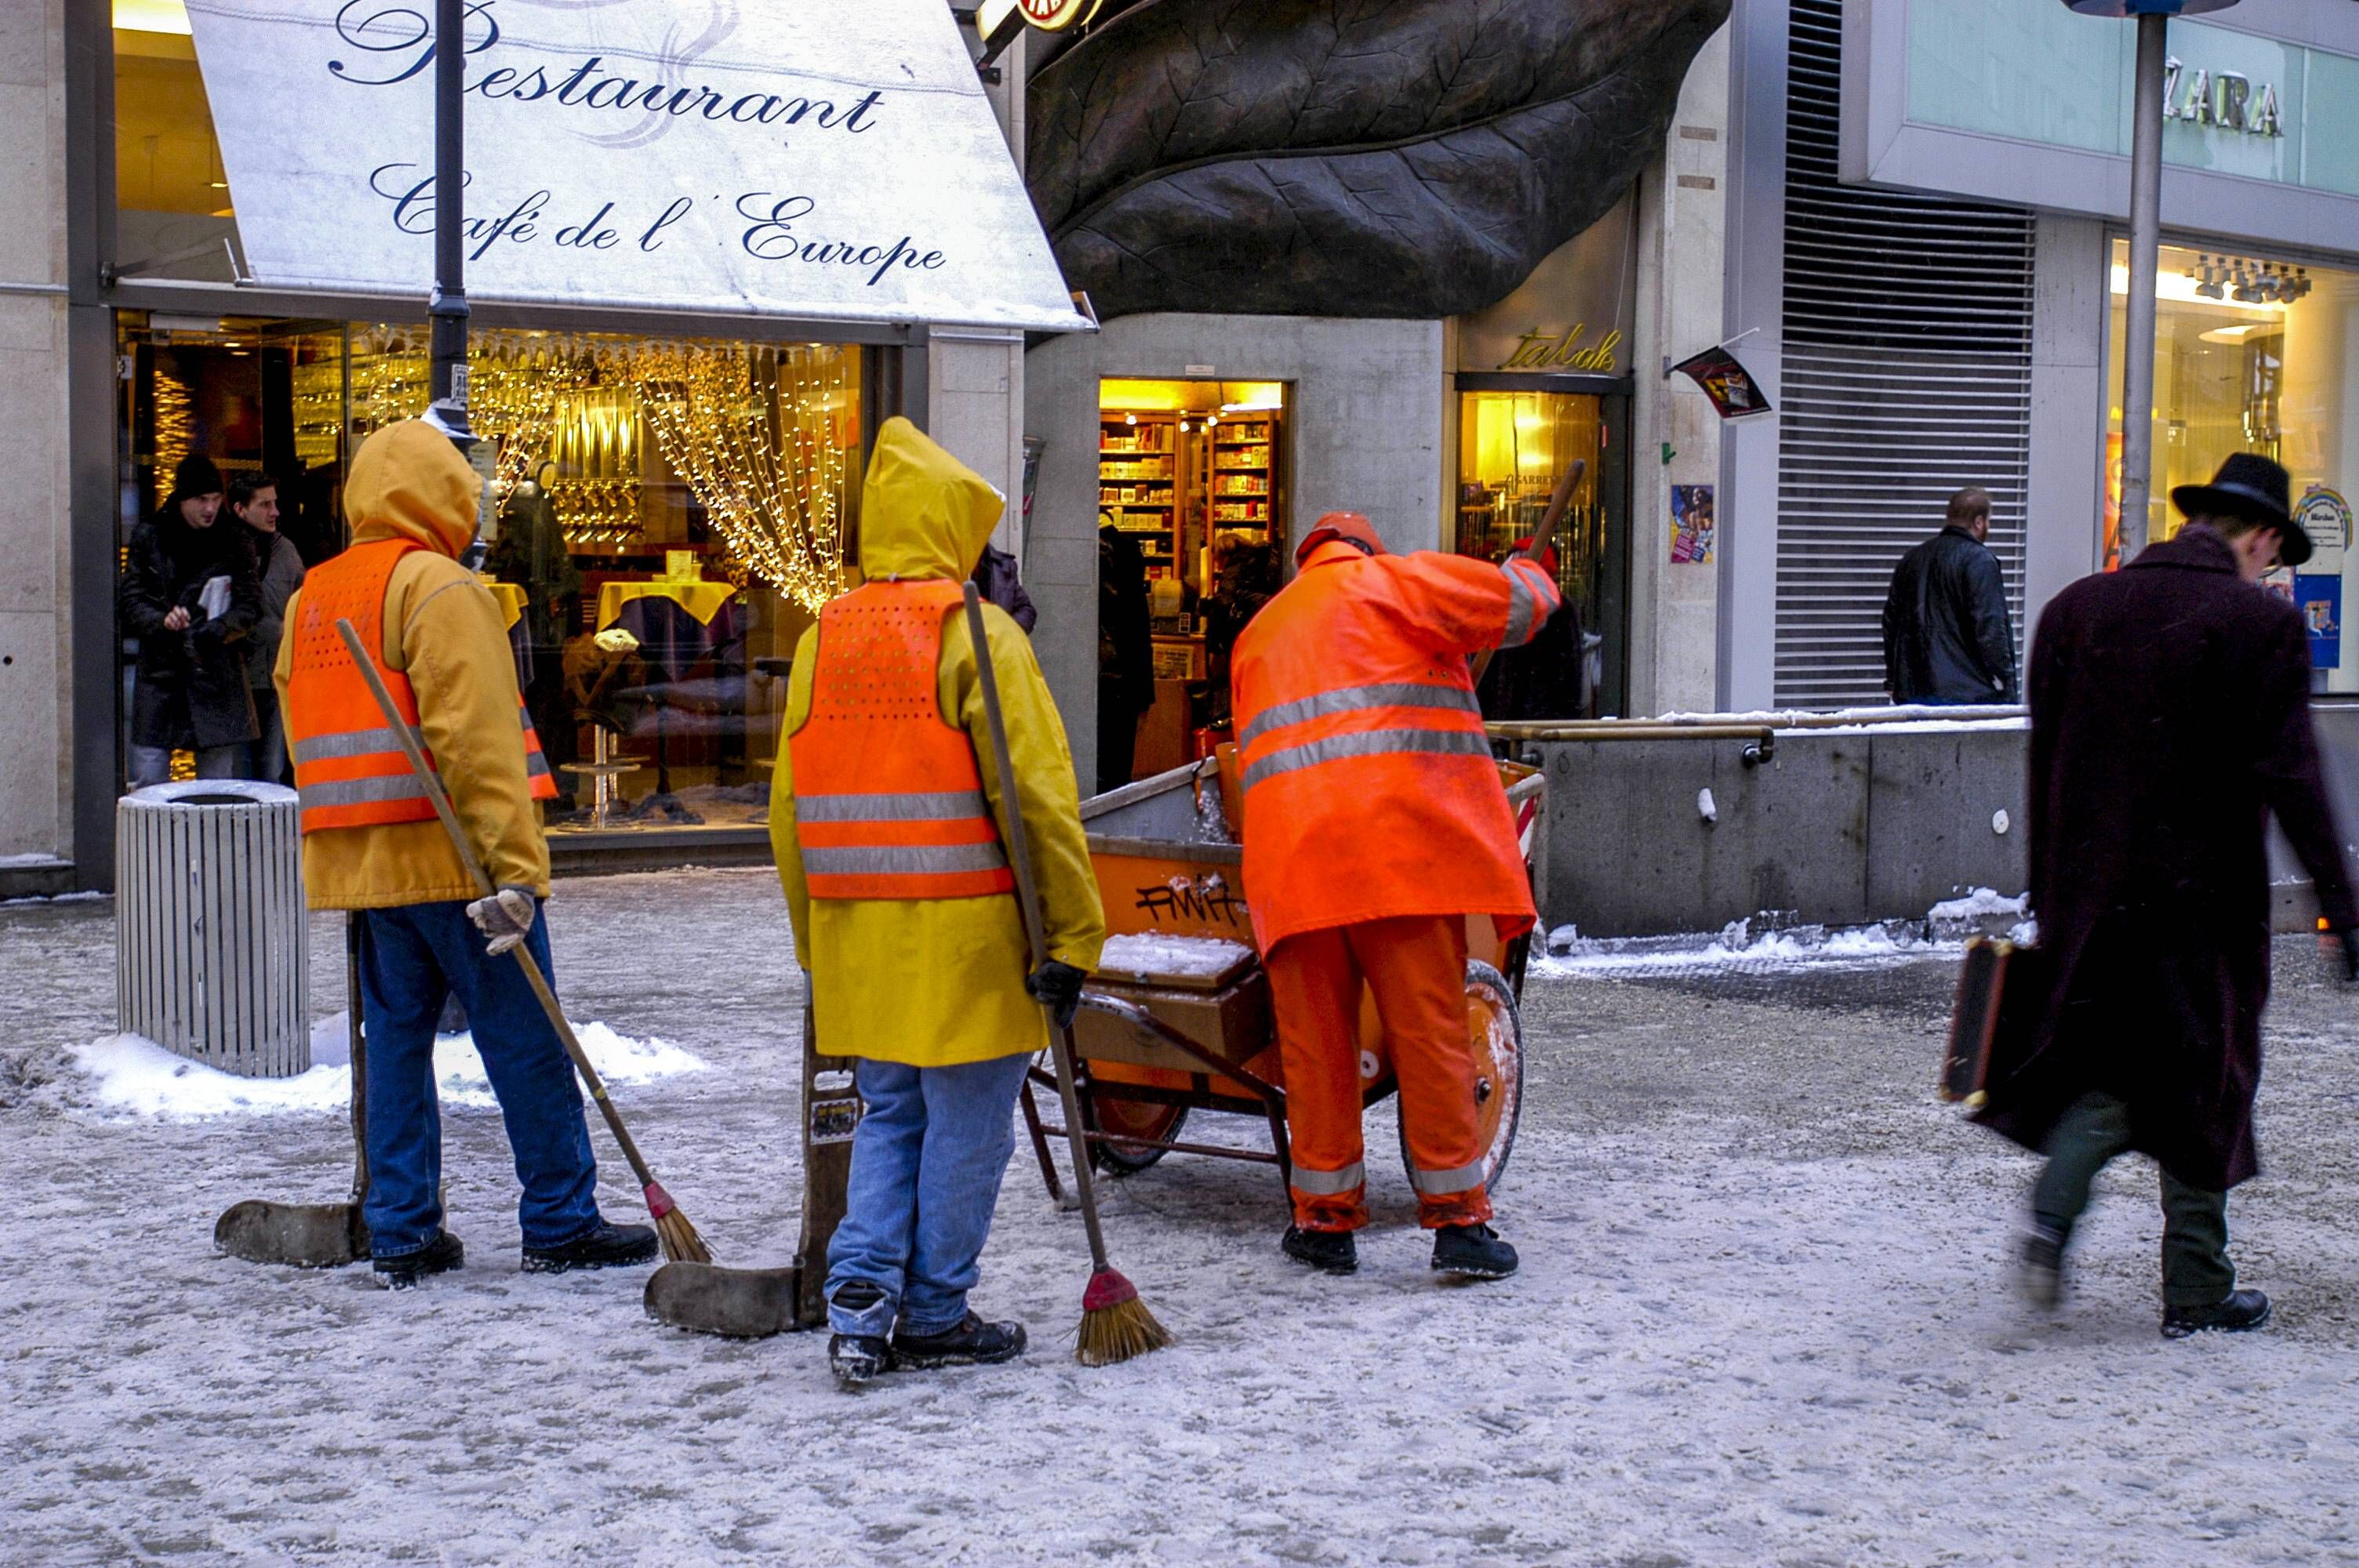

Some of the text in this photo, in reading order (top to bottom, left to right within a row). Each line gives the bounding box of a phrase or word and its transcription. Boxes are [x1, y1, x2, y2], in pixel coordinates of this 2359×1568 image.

[2162, 56, 2284, 137] ZARA
[555, 201, 620, 249] de
[736, 192, 947, 285] Europe
[1496, 323, 1622, 372] tabak
